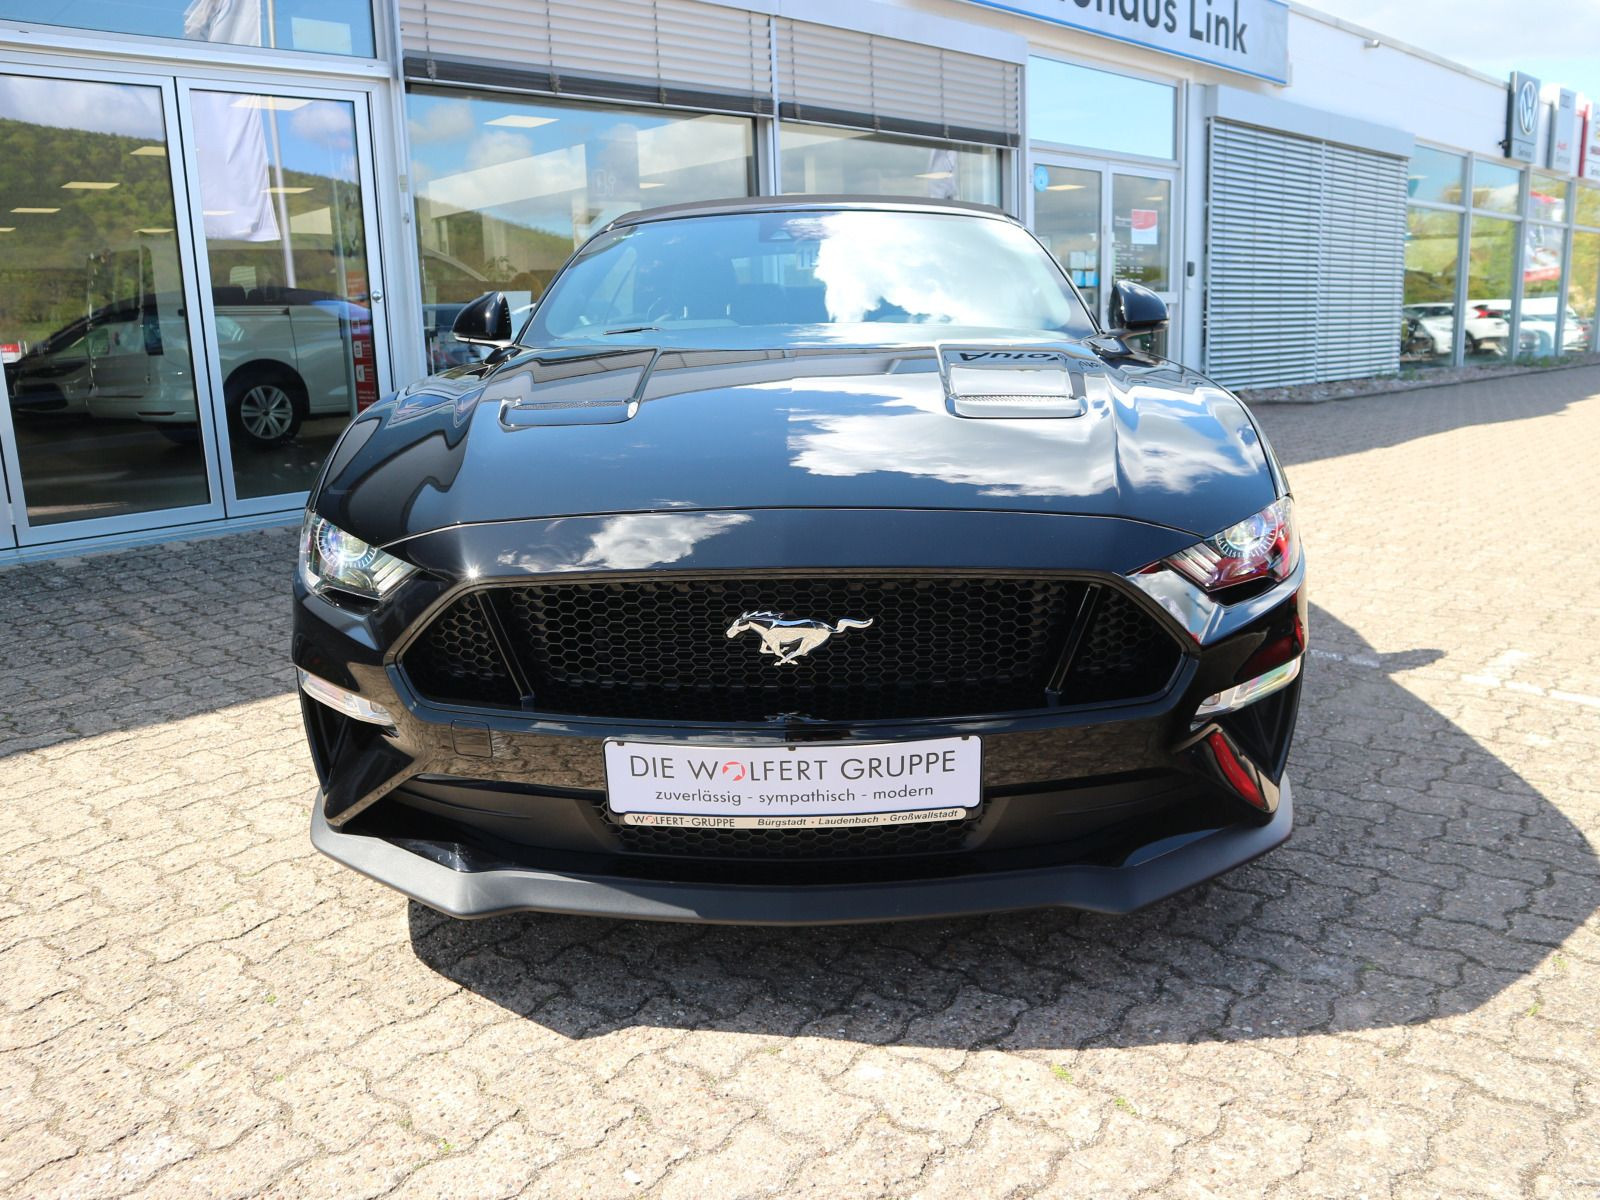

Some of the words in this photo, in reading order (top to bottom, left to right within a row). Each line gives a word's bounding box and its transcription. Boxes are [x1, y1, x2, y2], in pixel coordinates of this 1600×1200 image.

[1189, 0, 1248, 54] Link
[630, 755, 675, 779] DIE
[687, 759, 828, 782] WOLFERT
[840, 750, 956, 780] GRUPPE
[655, 789, 741, 806] zuverlässig
[759, 788, 855, 806] sympathisch
[873, 784, 934, 800] modern
[632, 815, 735, 827] WOLFERT-GRUPPE
[757, 817, 807, 826] Bürgstadt
[818, 816, 879, 825] Laudenbach
[889, 810, 958, 823] Großwallstadt
